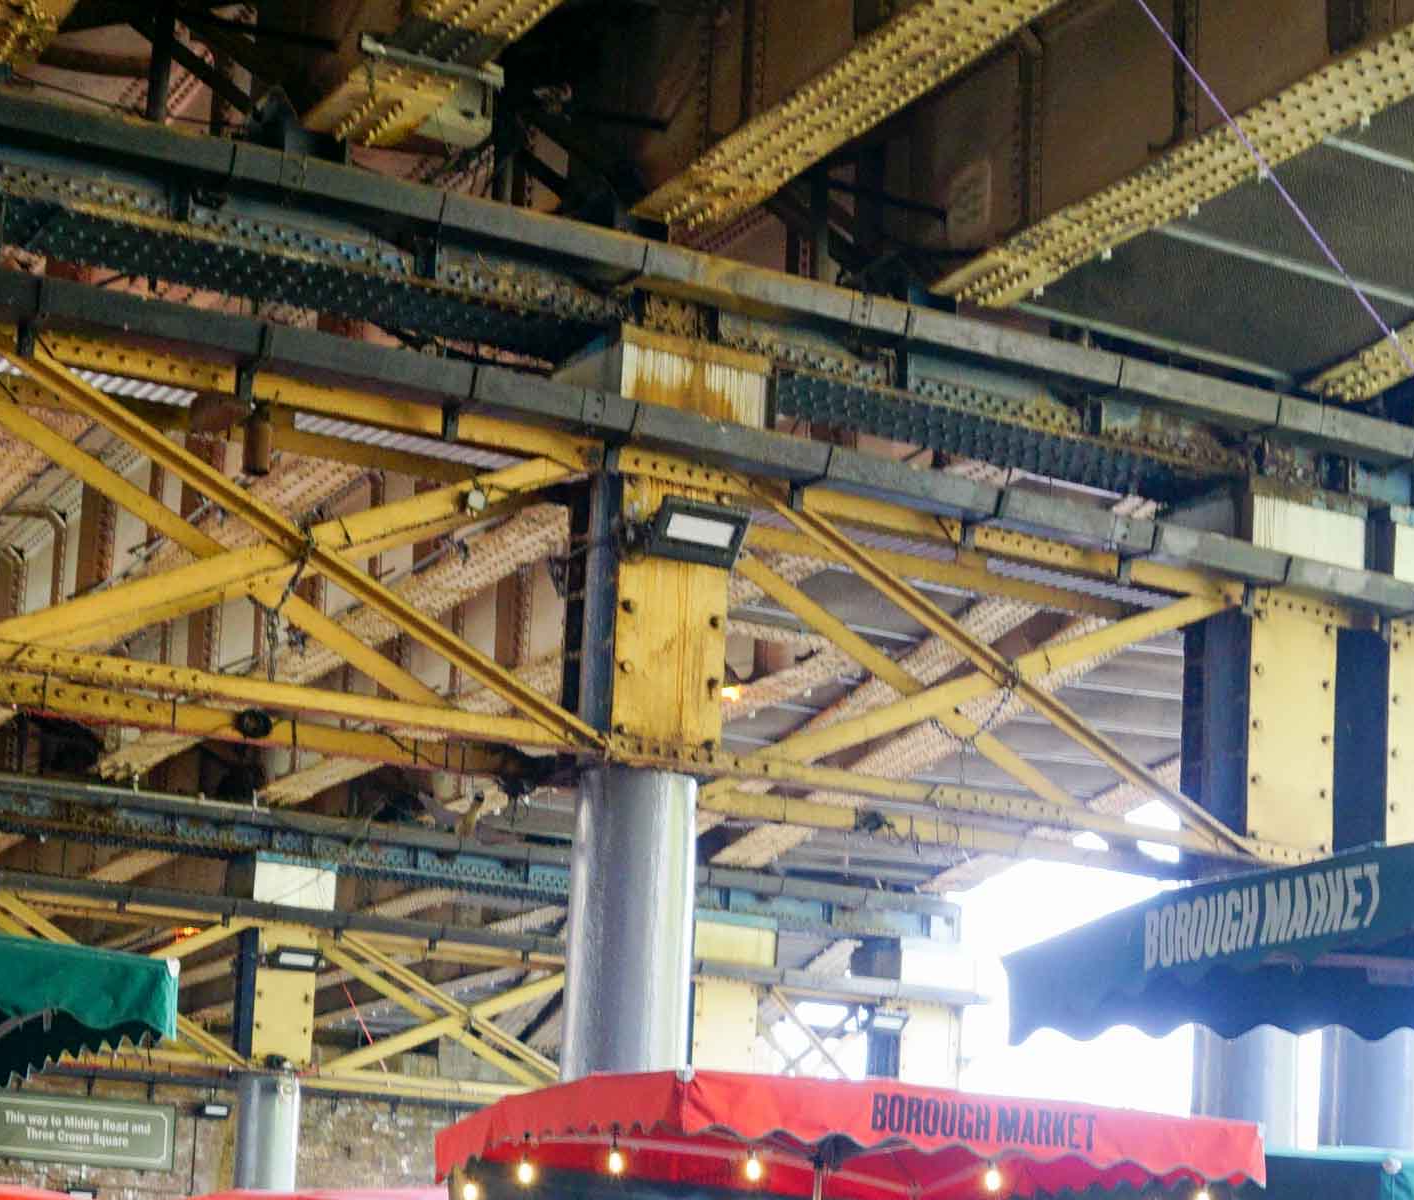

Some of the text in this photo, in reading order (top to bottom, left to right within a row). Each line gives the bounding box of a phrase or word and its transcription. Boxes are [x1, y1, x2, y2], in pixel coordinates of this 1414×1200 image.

[1144, 863, 1380, 972] BOROUGH MARKET
[4, 1110, 152, 1136] This way to Middle Road and
[26, 1126, 129, 1148] Three Crown Square
[871, 1092, 1097, 1152] BOROUGH MARKET
